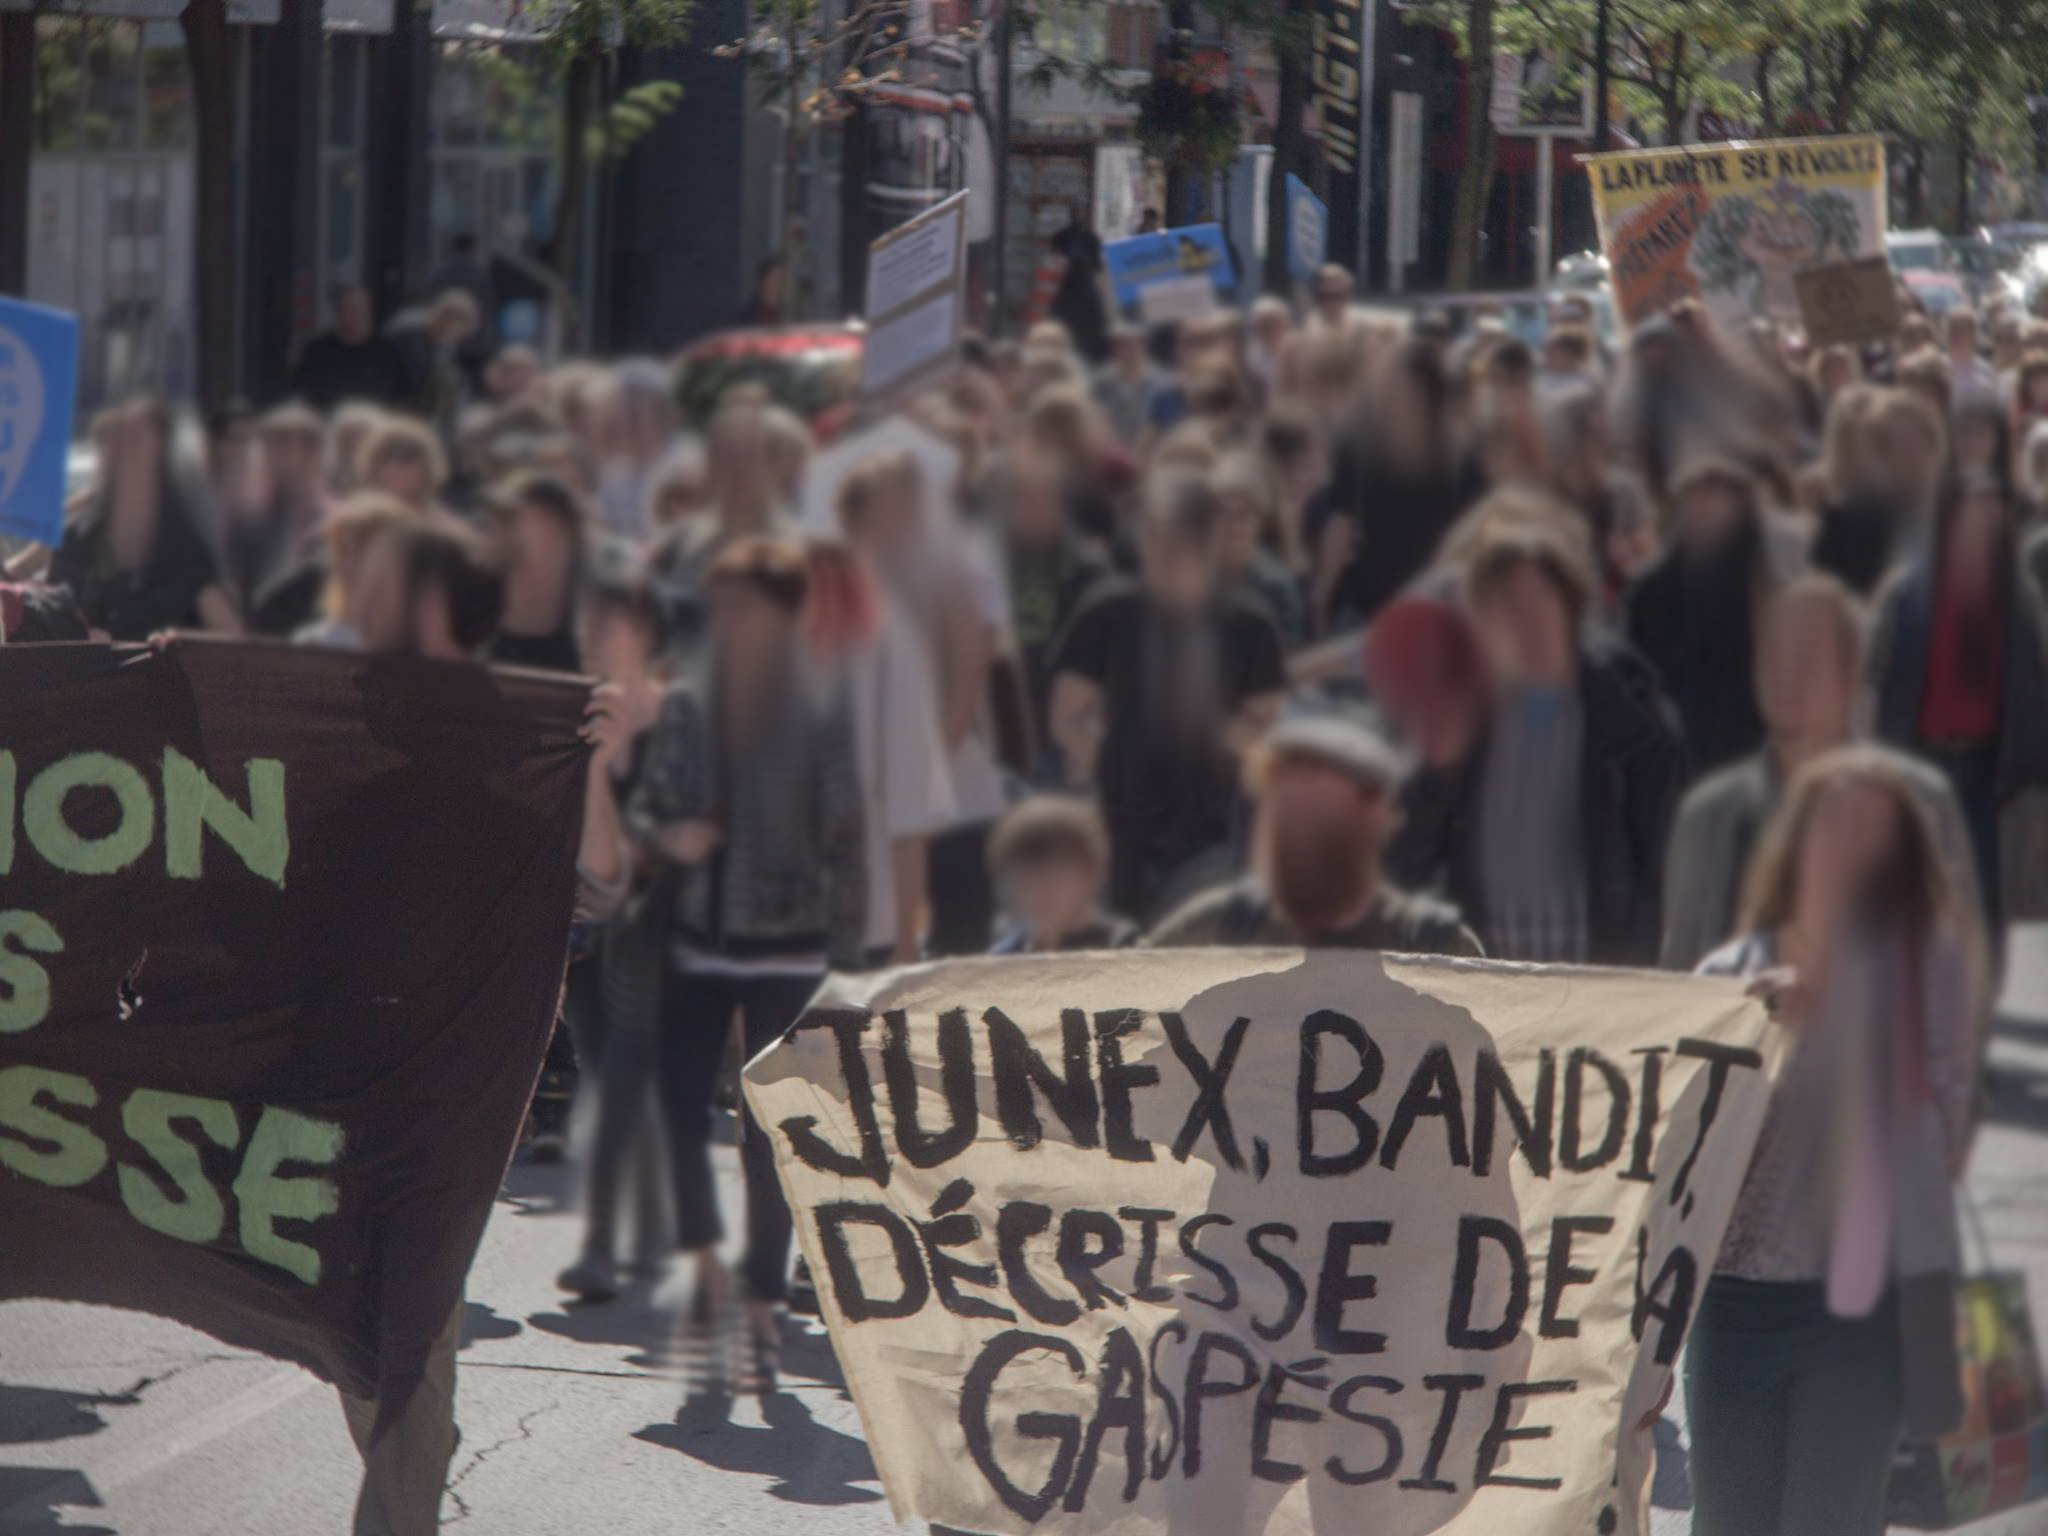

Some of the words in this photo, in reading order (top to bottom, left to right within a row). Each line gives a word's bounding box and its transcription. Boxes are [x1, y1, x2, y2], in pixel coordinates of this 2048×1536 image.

[1739, 152, 1771, 180] SE
[779, 1004, 1270, 1187] JUNEX,
[814, 1177, 1393, 1354] DÉCRISSE
[1446, 1213, 1615, 1351] DE
